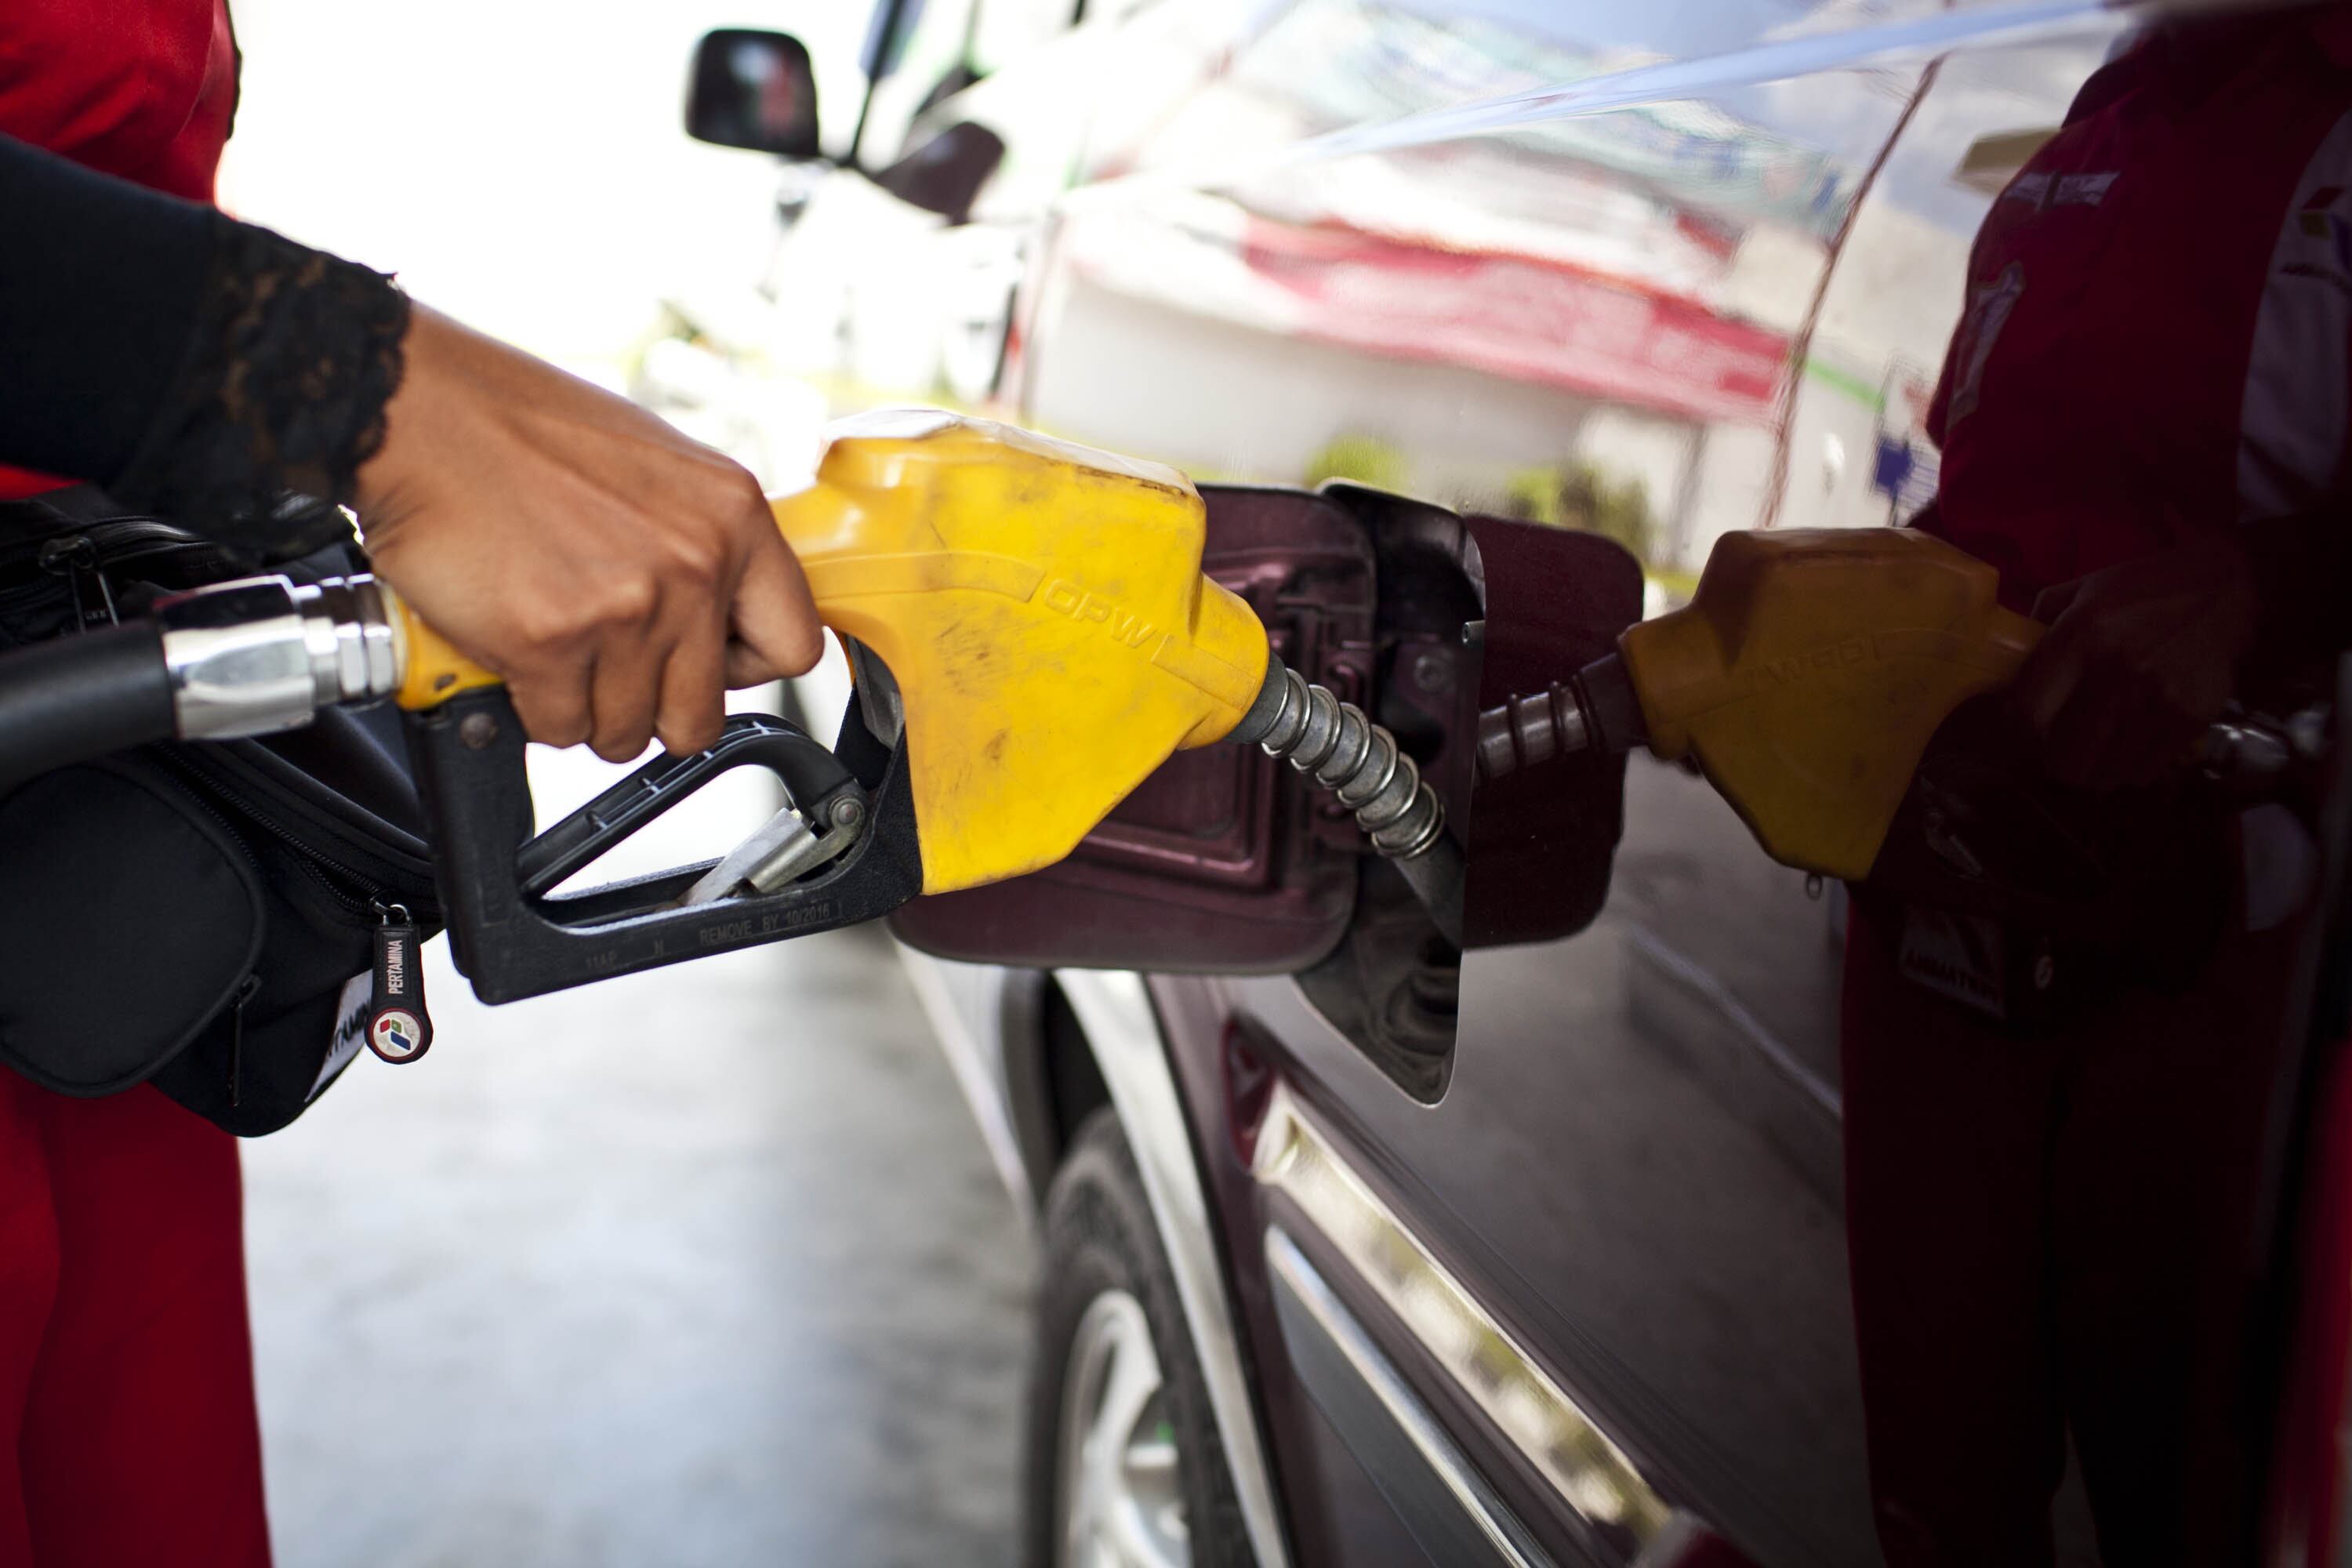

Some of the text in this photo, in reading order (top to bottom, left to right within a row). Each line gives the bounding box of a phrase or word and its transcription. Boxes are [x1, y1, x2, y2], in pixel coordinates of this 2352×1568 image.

[1043, 579, 1159, 649] OPW
[699, 920, 753, 946] REMOVE
[762, 915, 780, 931] BY
[387, 940, 404, 994] PERTAMINA
